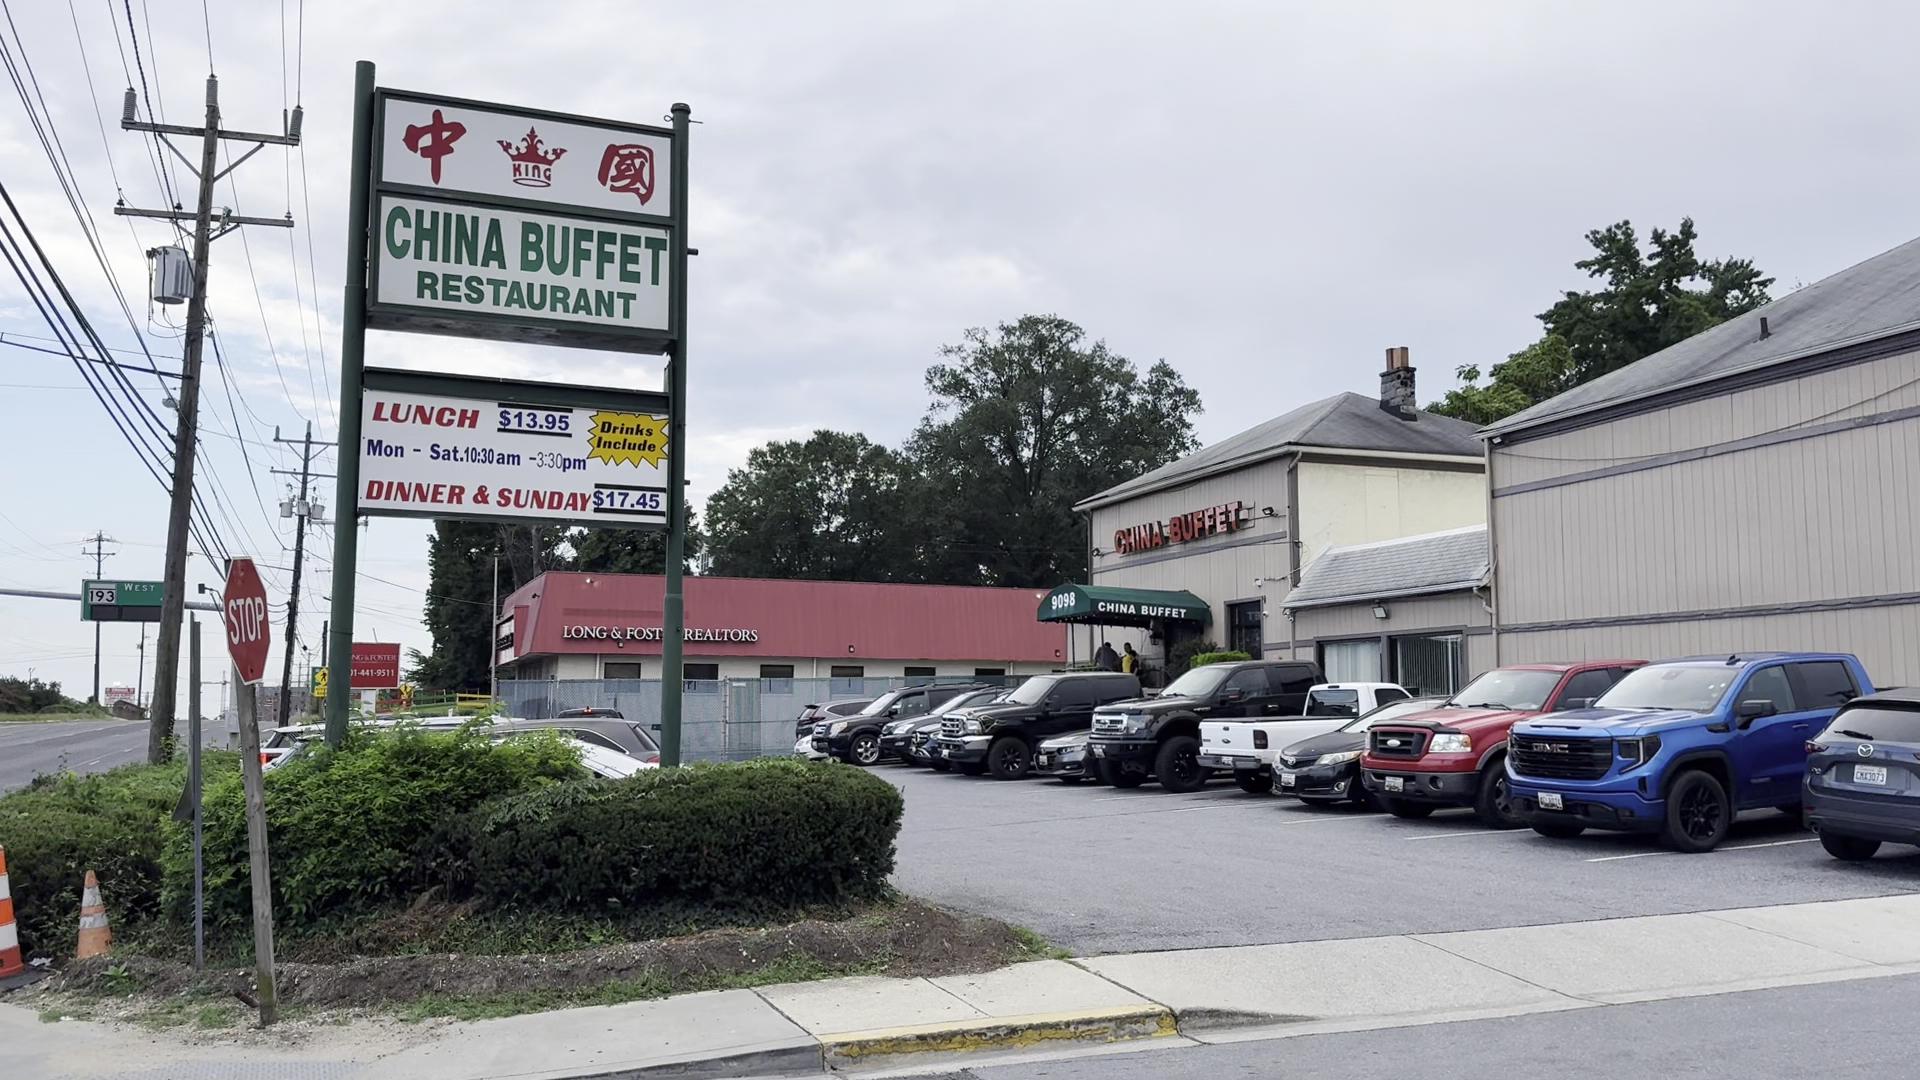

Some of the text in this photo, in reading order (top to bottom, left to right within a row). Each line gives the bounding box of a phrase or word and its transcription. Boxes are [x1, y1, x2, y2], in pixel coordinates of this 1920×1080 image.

[402, 109, 655, 206] 中 國
[512, 163, 552, 182] KING
[386, 206, 667, 286] CHINA BUFFET
[417, 270, 636, 319] RESTAURANT
[372, 402, 570, 431] LUNCH $13.95
[600, 421, 654, 437] Drinks
[367, 439, 405, 458] Mon
[596, 436, 657, 452] Include
[366, 480, 660, 512] DINNER & SUNDAY $17.45
[1114, 501, 1242, 554] CHINA BUFFET
[90, 590, 115, 602] 193
[124, 583, 155, 591] WEST
[1051, 592, 1076, 609] 9098
[1098, 602, 1187, 618] CHINA BUFFET
[229, 597, 264, 645] STOP
[563, 626, 758, 642] LONG & FOST REALTORS
[350, 669, 394, 677] 1-441-9511
